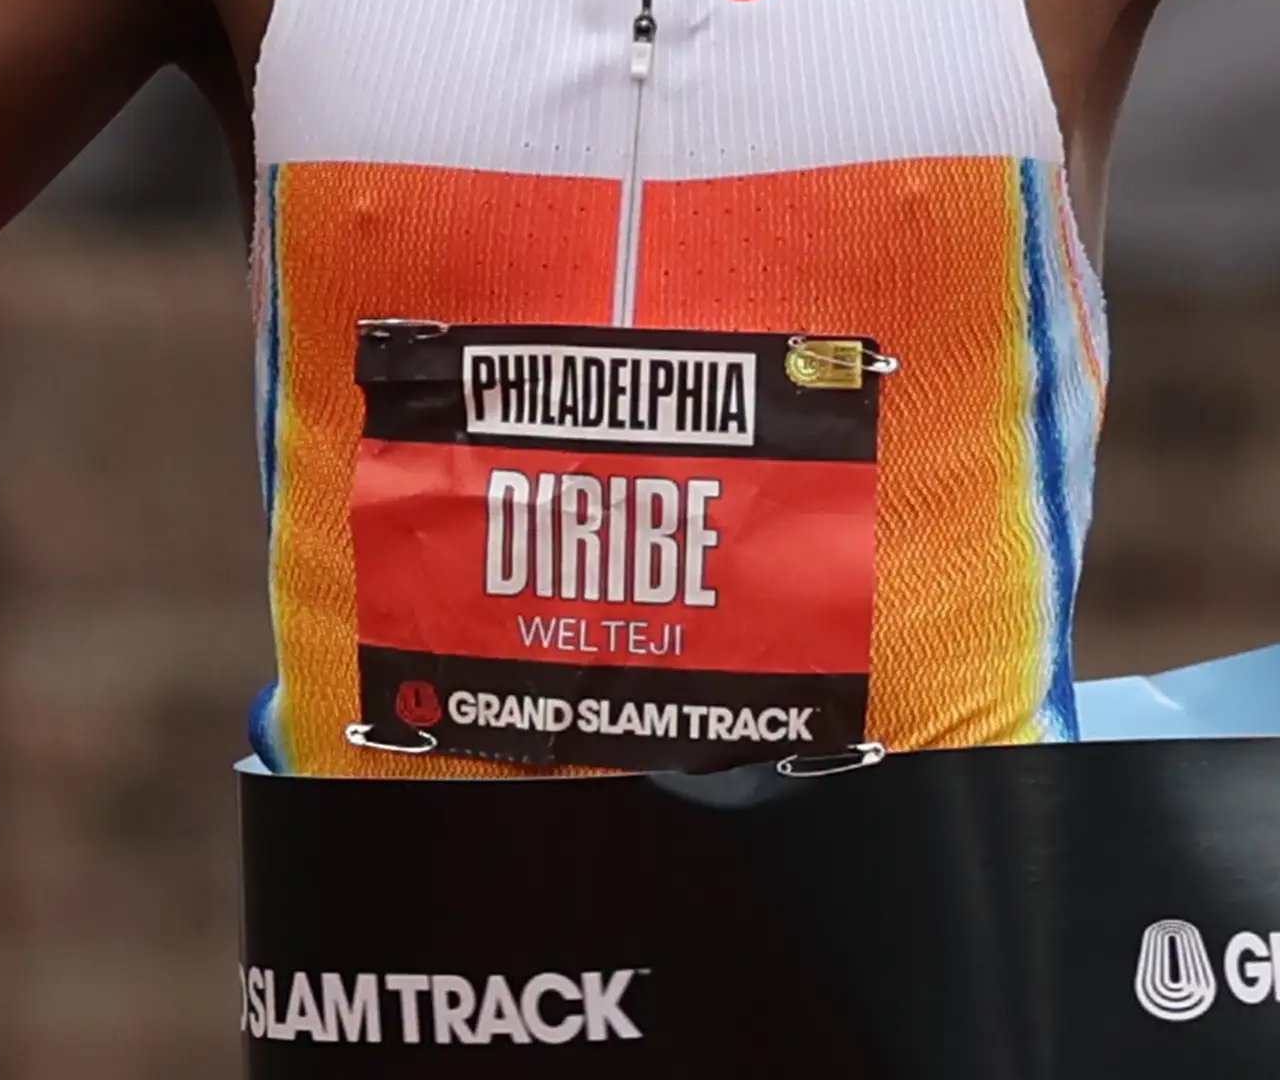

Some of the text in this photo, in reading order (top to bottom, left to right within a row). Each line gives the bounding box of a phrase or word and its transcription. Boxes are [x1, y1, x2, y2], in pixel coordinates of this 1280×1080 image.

[470, 353, 748, 434] PHILADELPHIA
[485, 469, 721, 607] DIRIBE
[518, 615, 684, 656] WELTEJI
[448, 690, 814, 743] GRAND SLAM TRACK
[247, 965, 382, 1043] SLAM
[384, 969, 643, 1044] TRACK
